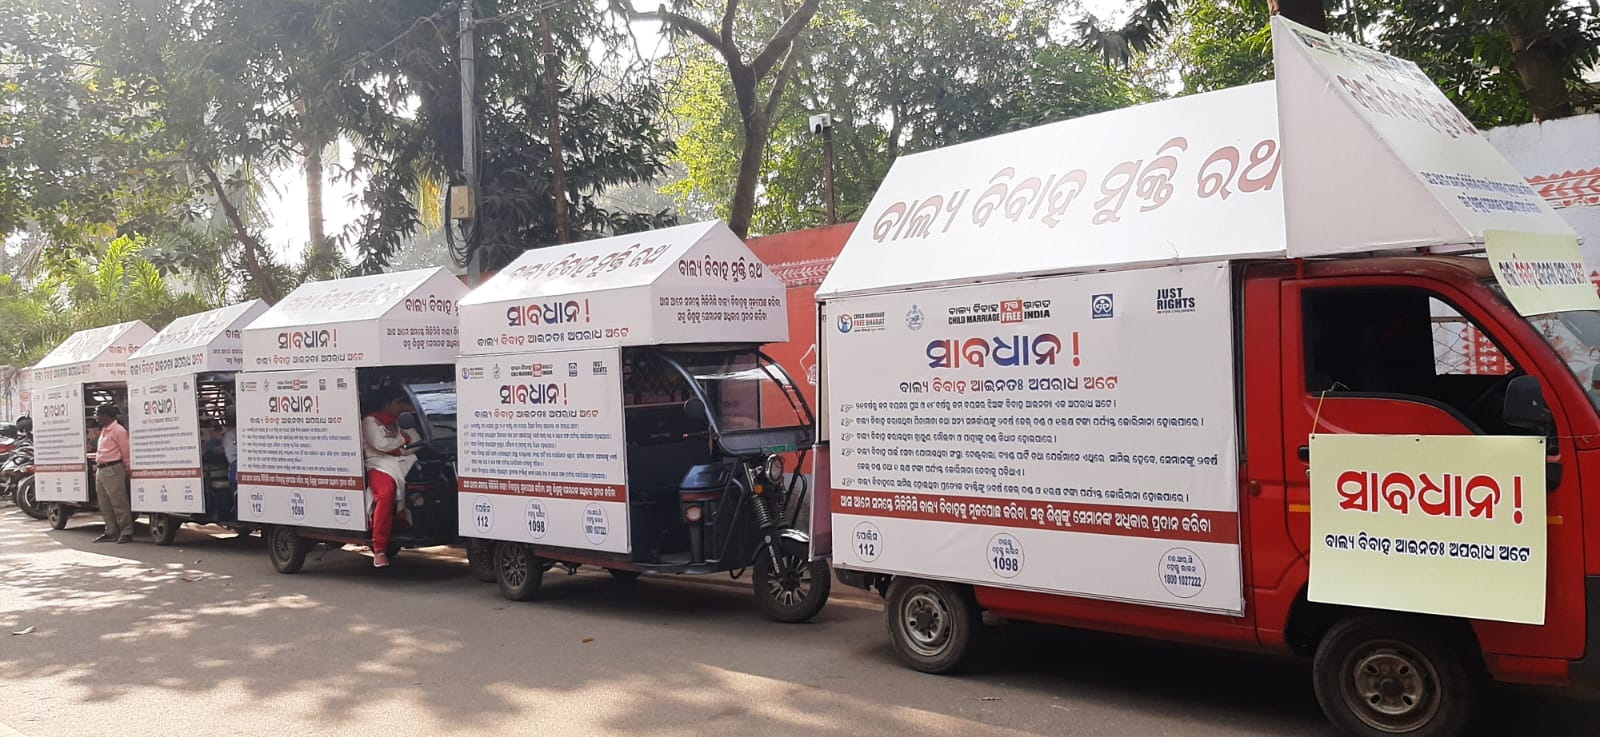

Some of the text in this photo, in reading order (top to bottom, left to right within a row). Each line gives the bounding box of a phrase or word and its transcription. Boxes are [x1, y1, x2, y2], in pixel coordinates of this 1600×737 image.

[873, 136, 1281, 243] ବାଲ୍ୟ ବିବାହ ମୁକ୍ତି ରଥ
[547, 253, 599, 278] ବିବାହ
[586, 243, 641, 278] ମୁକ୍ତି
[628, 244, 672, 268] ରଥ
[679, 255, 763, 282] ବାଲ୍ୟ ବିବାହ ମୁକ୍ତି ରଥ
[1157, 288, 1183, 299] JUST
[405, 294, 452, 315] ବାଲ୍ୟ ବିବାହ
[949, 307, 970, 315] ବାଲ୍ୟ
[973, 303, 999, 313] ବିବାହ
[1157, 297, 1195, 310] RIGHTS
[507, 299, 590, 327] ସାବଧାନ !
[949, 309, 1050, 325] CHILD MARRIAGE FREE INDIA
[278, 329, 337, 349] ସାବଧାନ !
[477, 338, 499, 347] ବାଲ୍ୟ
[500, 333, 525, 346] ବିବାହ
[567, 330, 603, 341] ଅପରାଧ
[604, 327, 629, 338] ଅଟେ
[926, 331, 1080, 369] ସାବଧାନ !
[500, 383, 568, 405] ସାବଧାନ !
[900, 376, 1118, 394] ବାଲ୍ୟ ବିବାହ ଆଇନତଃ ଅପରାଧ ଅଟେ
[268, 395, 314, 413] ସାବଧାନ
[474, 410, 492, 418] ବାଲ୍ୟ
[494, 408, 514, 419] ବିବାହ
[1337, 470, 1523, 524] ସାବଧାନ !
[477, 516, 488, 527] 112
[853, 496, 871, 508] ଆମେ
[894, 495, 918, 512] ମିଳିମିଶି
[919, 500, 938, 513] ବାଲ୍ୟ
[939, 498, 967, 519] ବିବାହକୁ
[1030, 507, 1045, 525] ସବୁ
[1046, 504, 1071, 526] ଶିଶୁଙ୍କୁ
[1073, 510, 1113, 526] ସେମାନଙ୍କ
[1114, 513, 1150, 529] ଅଧିକାର
[1151, 515, 1178, 532] ପ୍ରଦାନ
[1181, 513, 1211, 533] କରିବା
[528, 521, 545, 533] 1098
[856, 529, 877, 540] ପୋଲିସ
[858, 543, 875, 556] 112
[1325, 531, 1530, 561] ବାଲ୍ୟ ବିବାହ ଆଇନତଃ ଅପରାଧ ଅଟେ
[993, 556, 1018, 571] 1098
[1164, 573, 1202, 587] 1800 1027222
